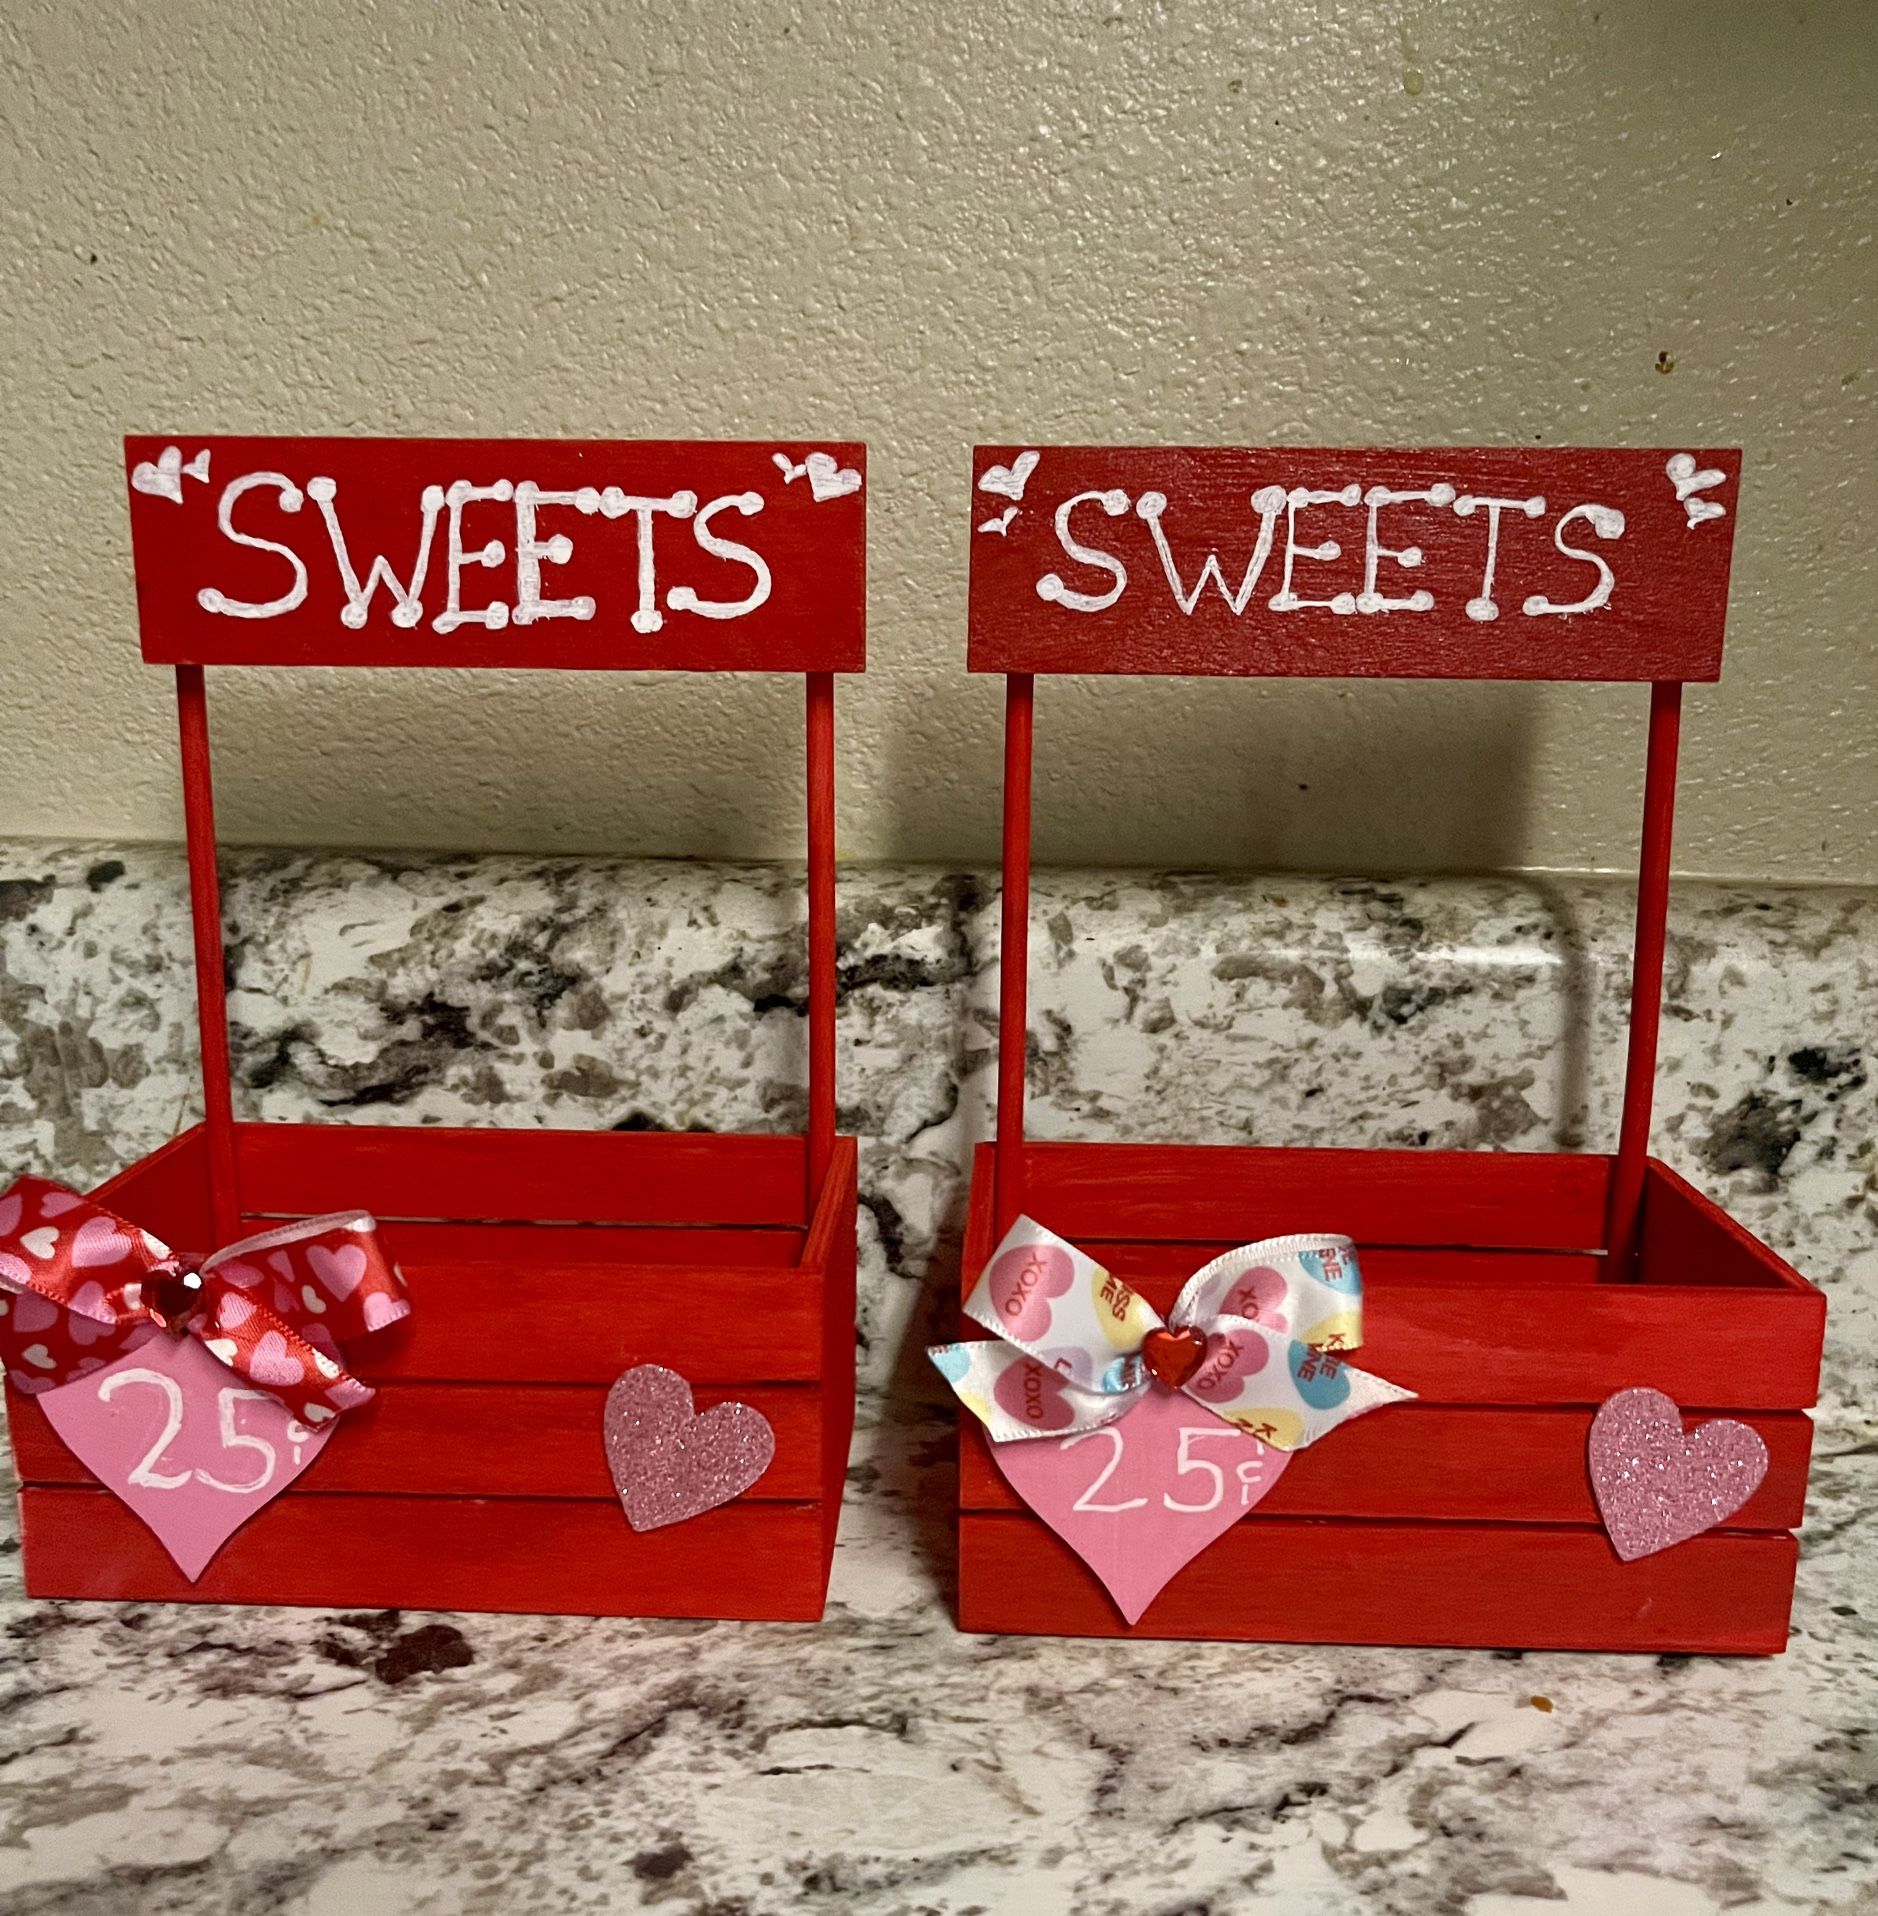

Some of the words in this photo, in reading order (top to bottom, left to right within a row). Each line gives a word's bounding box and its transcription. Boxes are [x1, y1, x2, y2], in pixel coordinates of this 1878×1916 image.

[197, 471, 773, 634] SWEETS
[1035, 484, 1626, 622] SWEETS
[1004, 1251, 1048, 1317] XOXO
[1023, 1361, 1045, 1420] XOXO
[1197, 1340, 1244, 1391] XOXO
